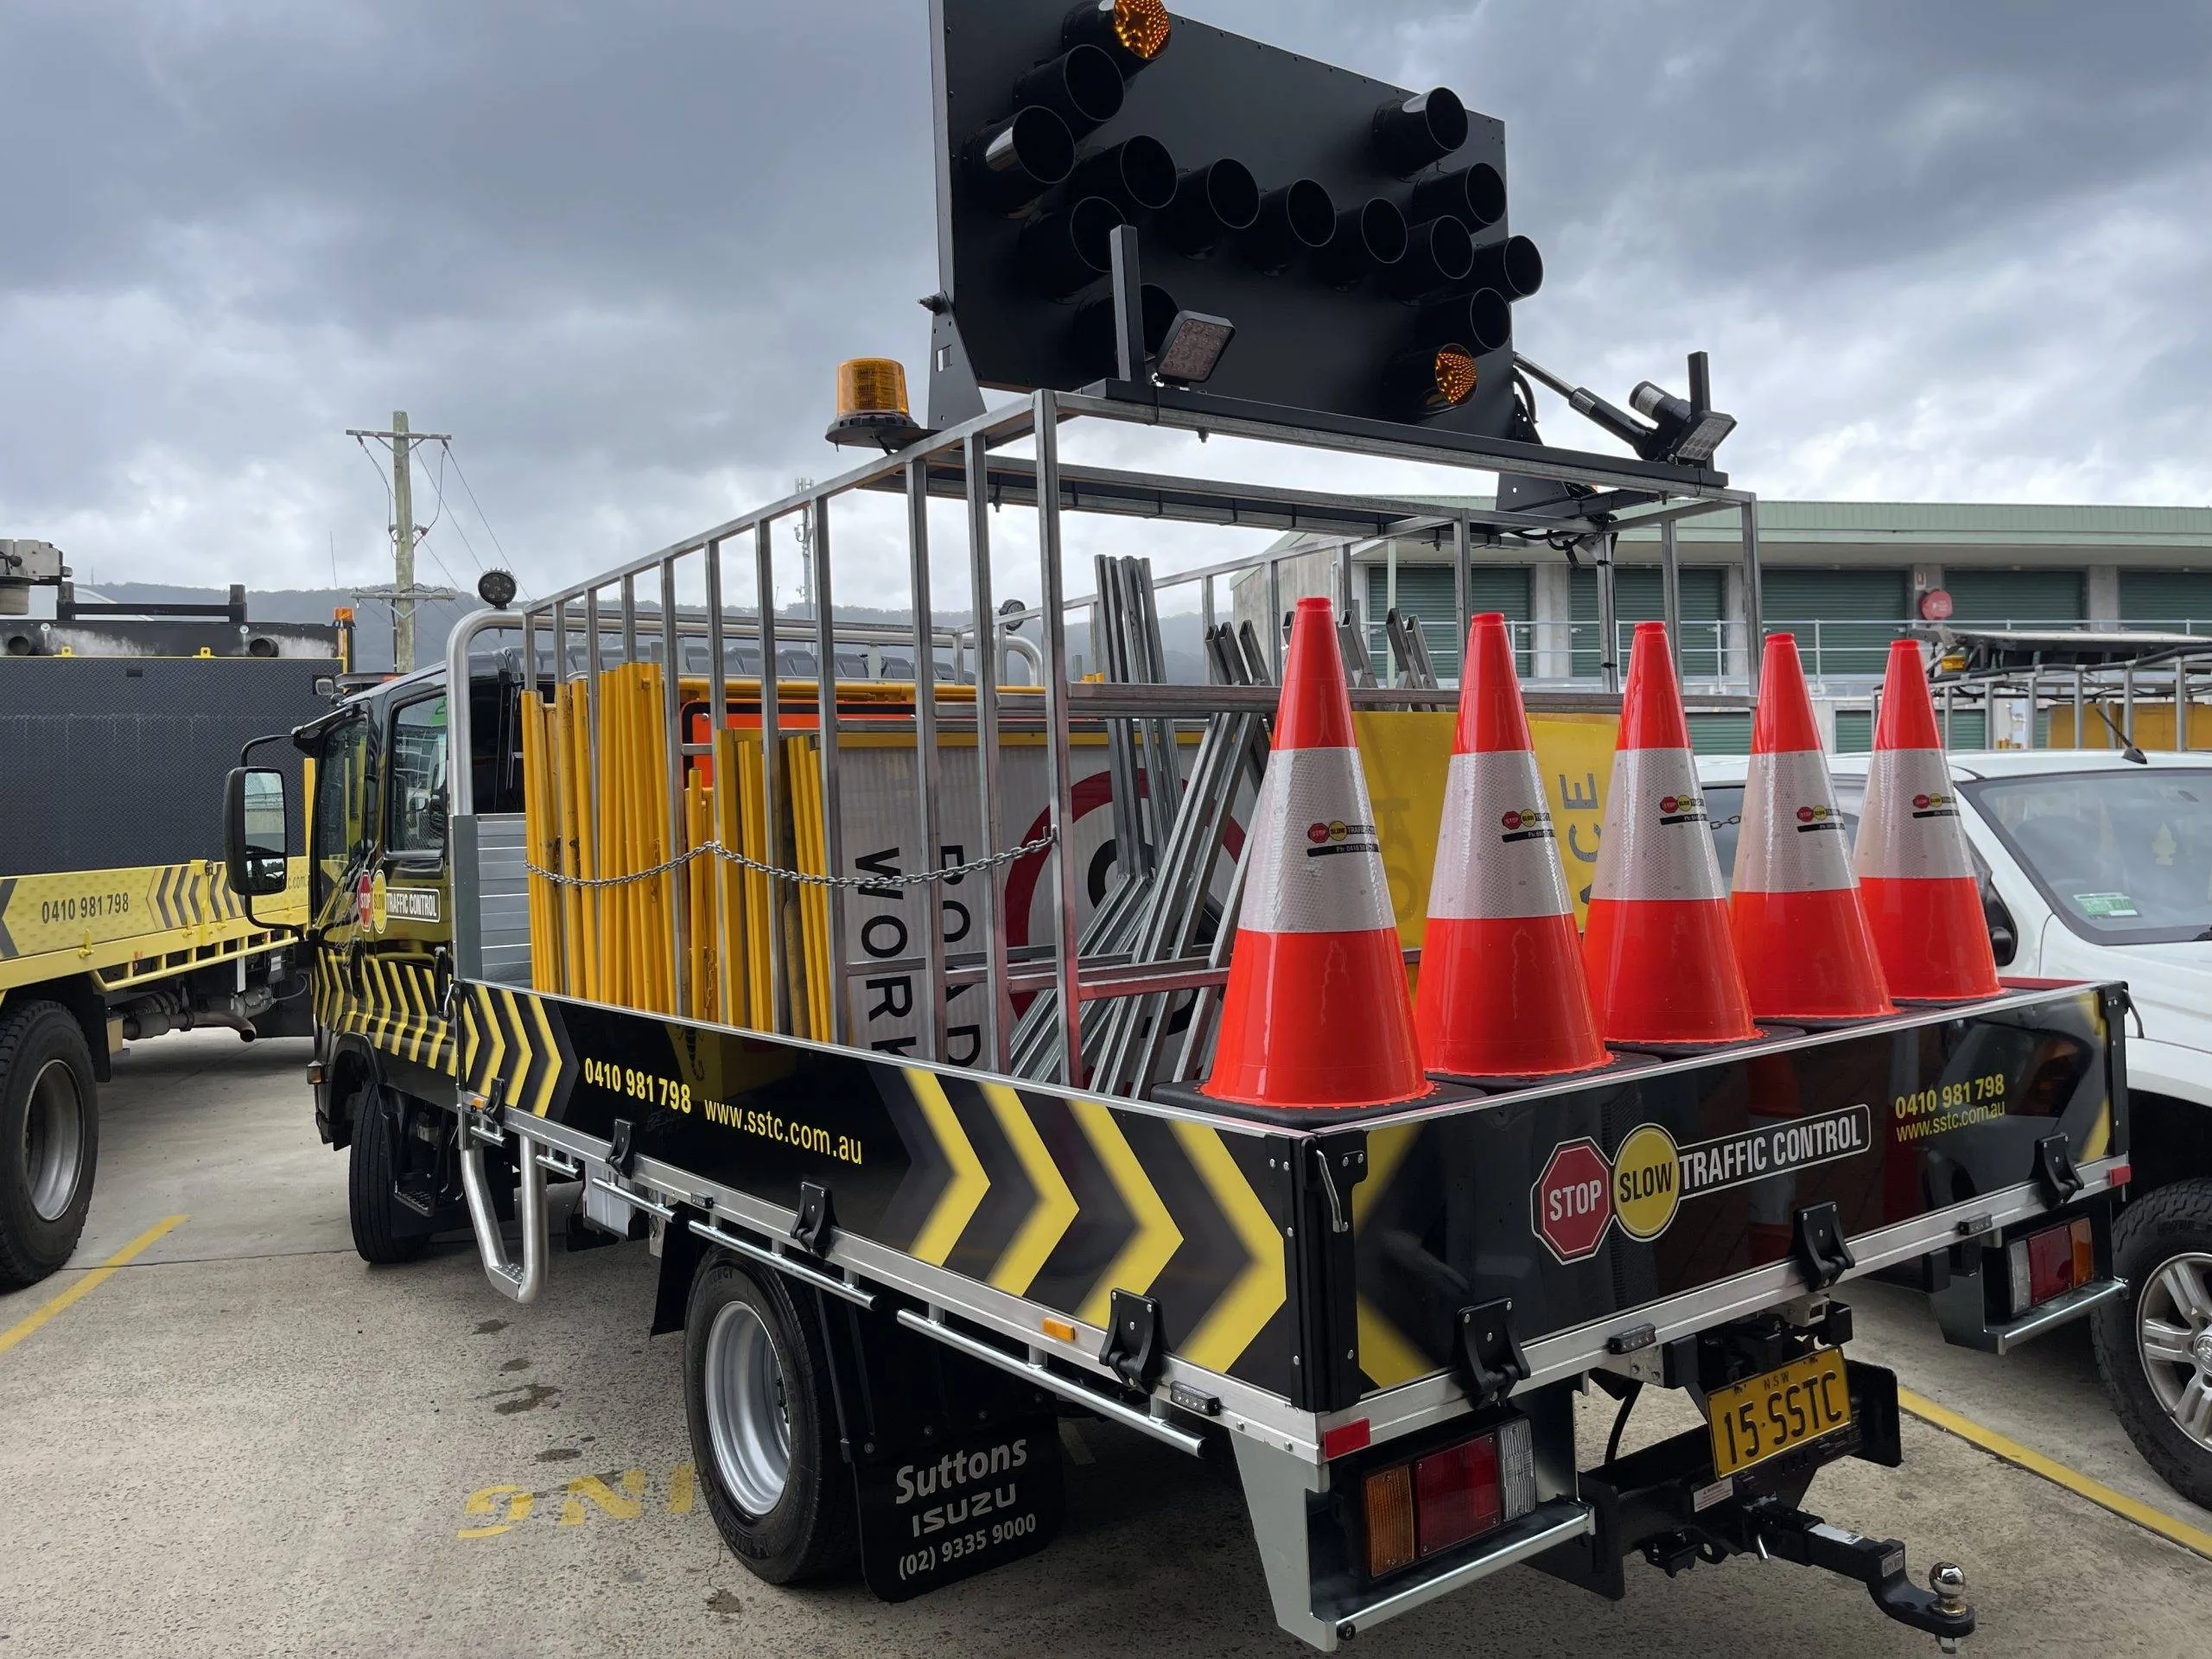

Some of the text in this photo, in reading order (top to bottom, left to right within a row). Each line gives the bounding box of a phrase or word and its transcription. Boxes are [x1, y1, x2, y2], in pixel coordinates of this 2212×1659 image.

[41, 892, 129, 925] 0410 981 798
[360, 892, 437, 917] STOP SLOW TRAFFIC CONTROL
[584, 1058, 862, 1165] 0410 981 798 www.sstc.com.au
[1894, 1073, 2005, 1120] 0410 981 798
[1895, 1100, 2005, 1144] www.sstc.com.au
[1548, 1114, 1862, 1222] STOP SLOW TRAFFIC CONTROL
[1764, 1370, 1789, 1391] NSW
[896, 1439, 1027, 1504] Suttons
[912, 1483, 1016, 1538] ISUZU
[899, 1513, 1036, 1580] (02) 9335 9000
